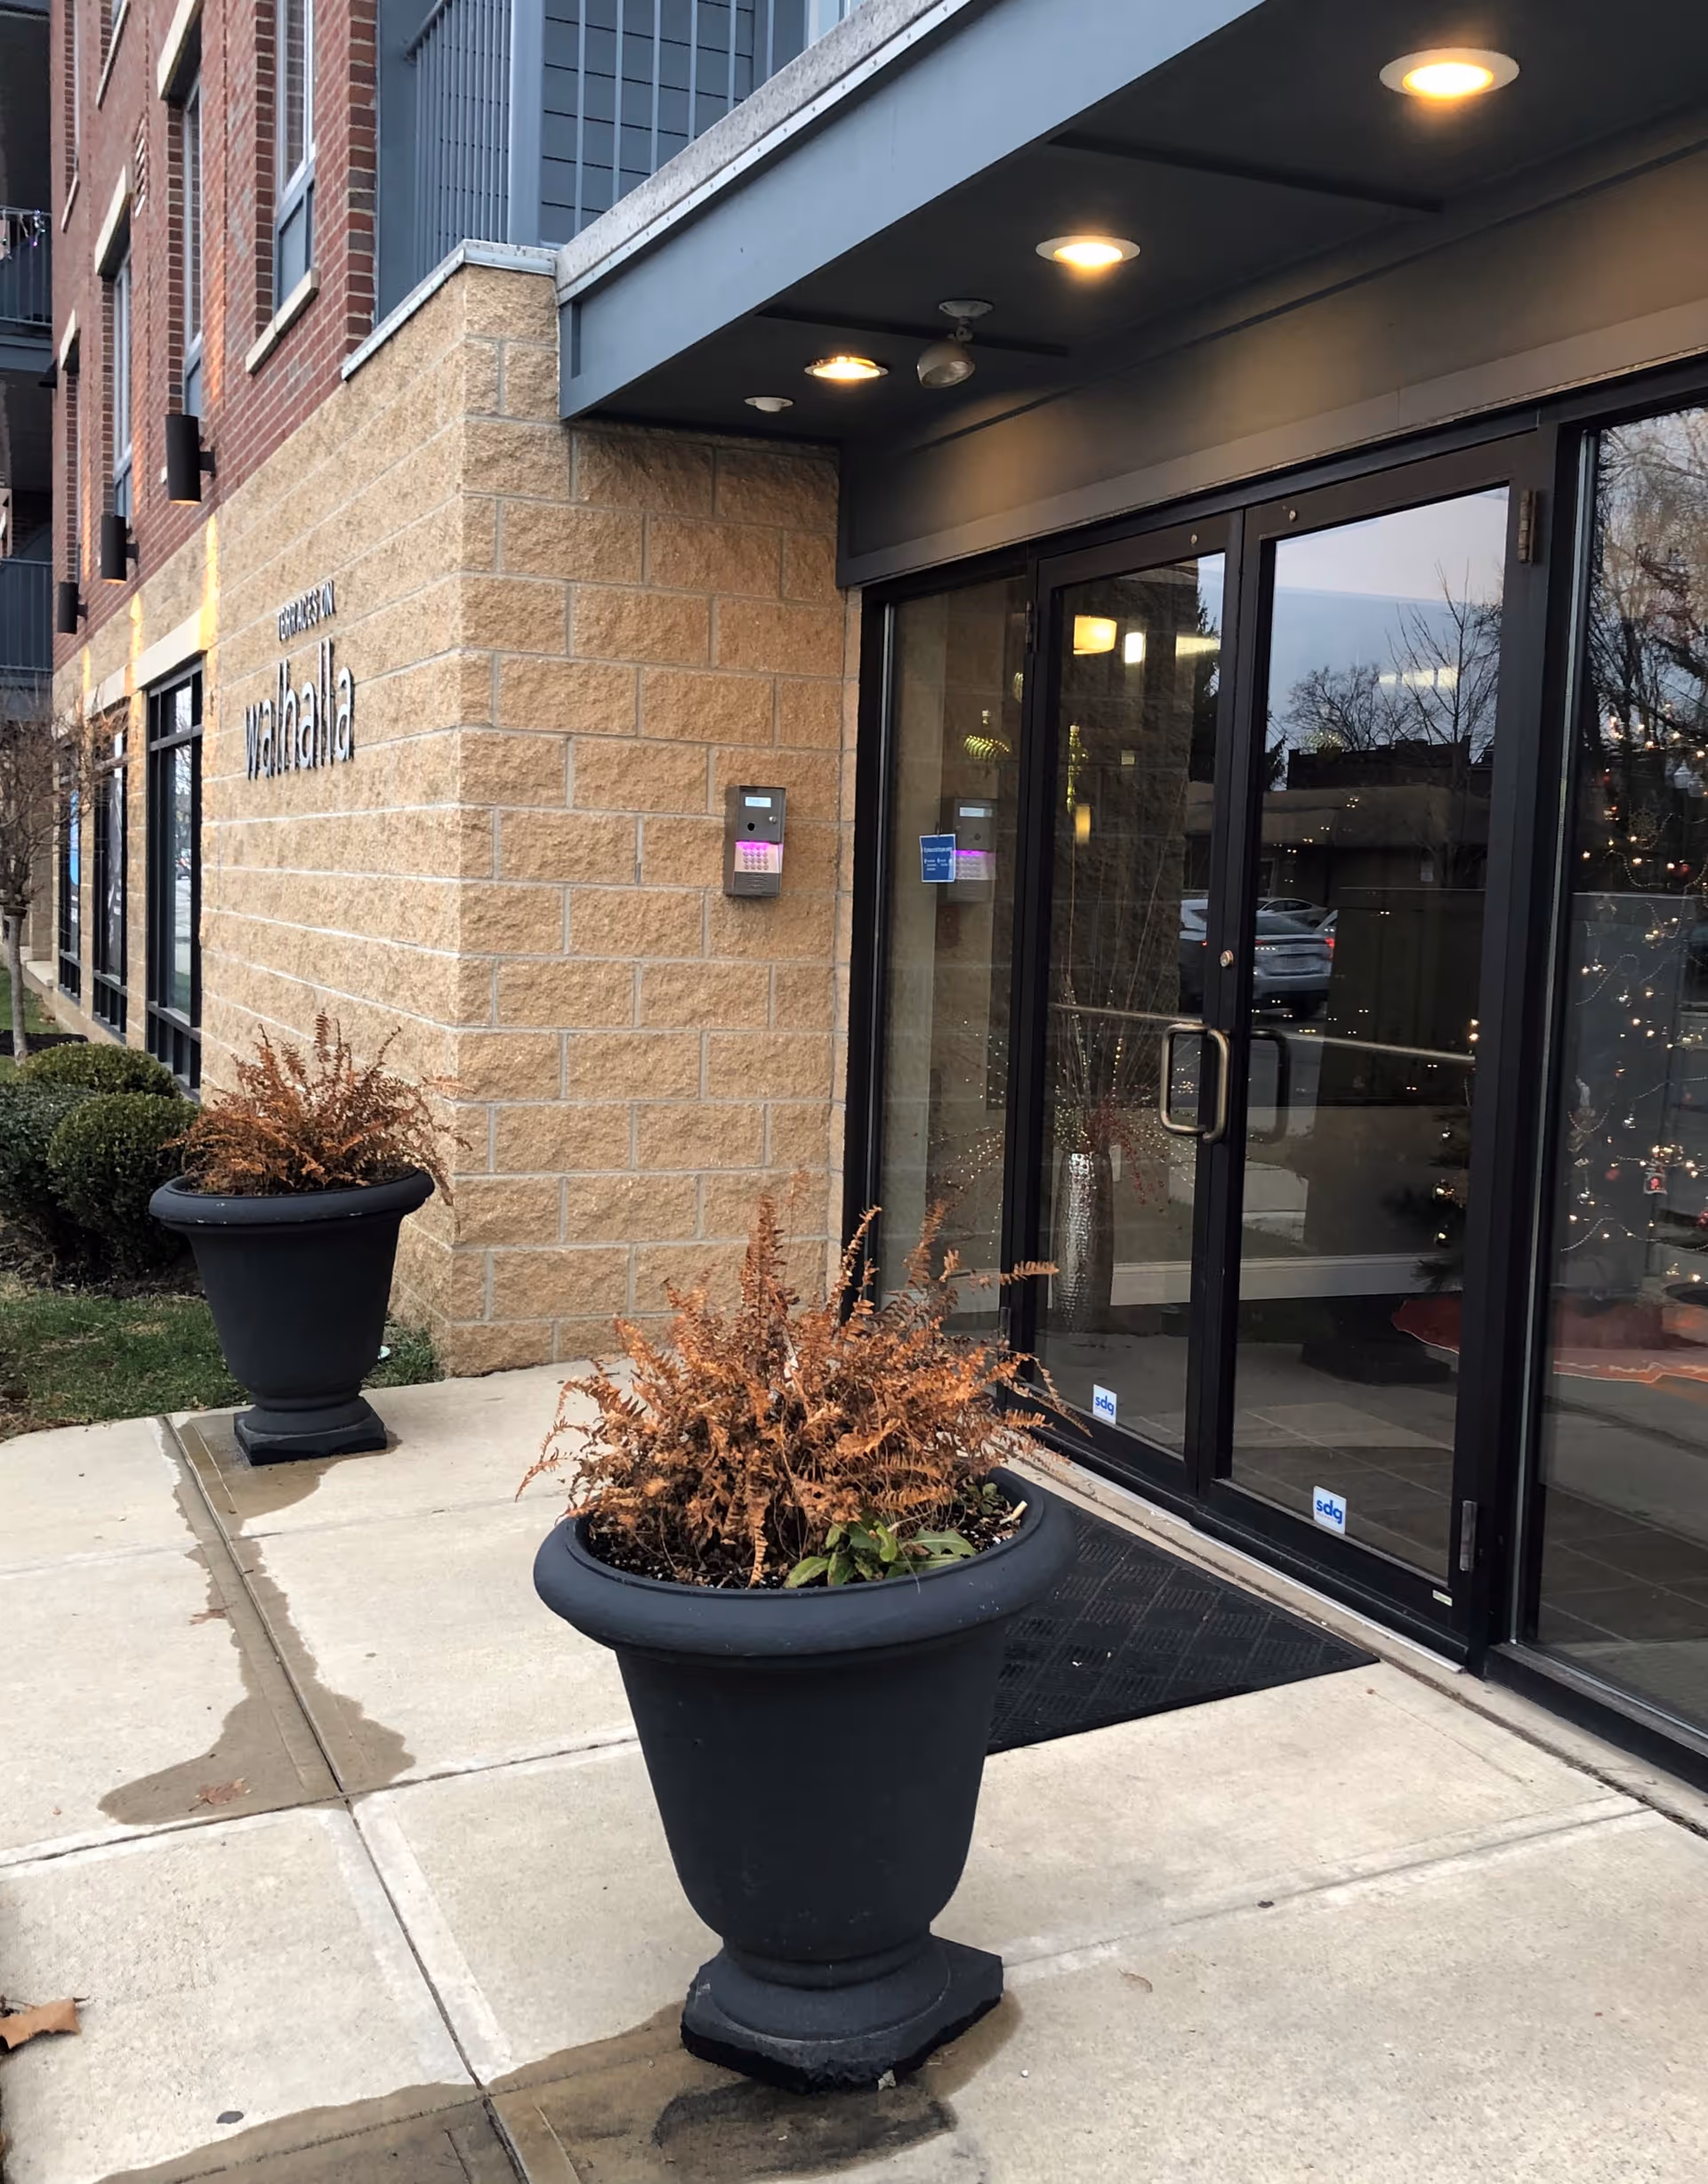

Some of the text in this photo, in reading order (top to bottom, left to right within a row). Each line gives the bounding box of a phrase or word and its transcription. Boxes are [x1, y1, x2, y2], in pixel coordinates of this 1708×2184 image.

[278, 579, 336, 641] TERRACES ON
[245, 638, 355, 780] walhalla
[1095, 1395, 1115, 1416] sdg
[1316, 1499, 1343, 1525] sdg
